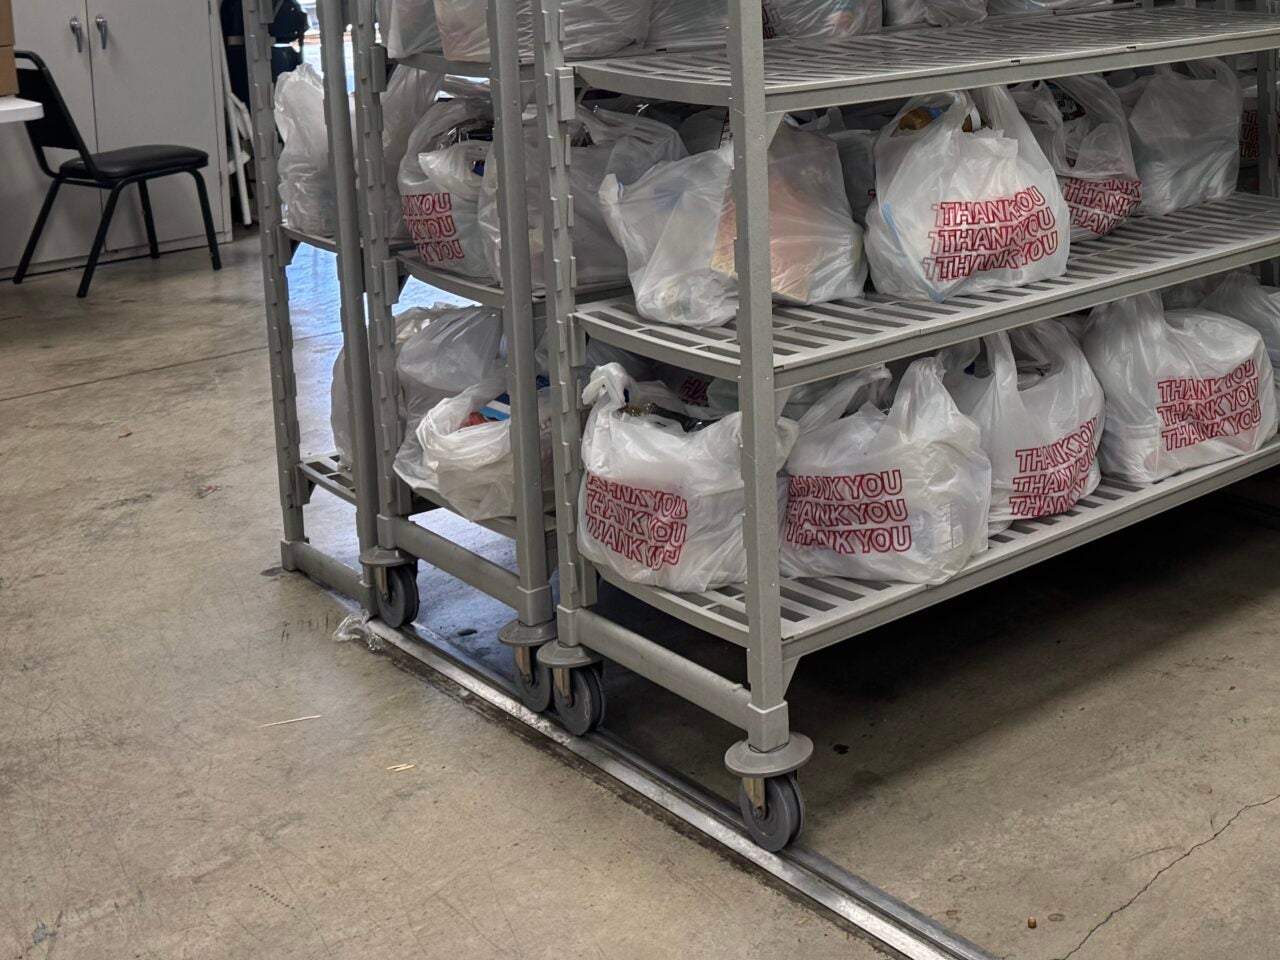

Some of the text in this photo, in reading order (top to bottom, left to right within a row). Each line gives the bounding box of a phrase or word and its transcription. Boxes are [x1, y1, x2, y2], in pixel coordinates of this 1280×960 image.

[941, 200, 1018, 226] THANK
[1064, 184, 1139, 218] THANK
[938, 207, 1055, 253] THANK YOU
[430, 239, 465, 261] YOU
[936, 231, 1058, 280] THANK YOU
[1158, 359, 1256, 403] THANK YOU
[1156, 378, 1259, 427] THANK YOU
[1162, 400, 1261, 451] THANK YOU
[1015, 434, 1077, 473] THANK
[842, 469, 903, 499] YOU
[1012, 465, 1076, 495] THAN
[649, 490, 688, 520] YOU
[847, 498, 908, 525] YOU
[646, 512, 687, 547] YOU
[852, 525, 912, 554] YOU
[645, 545, 682, 571] YOU
